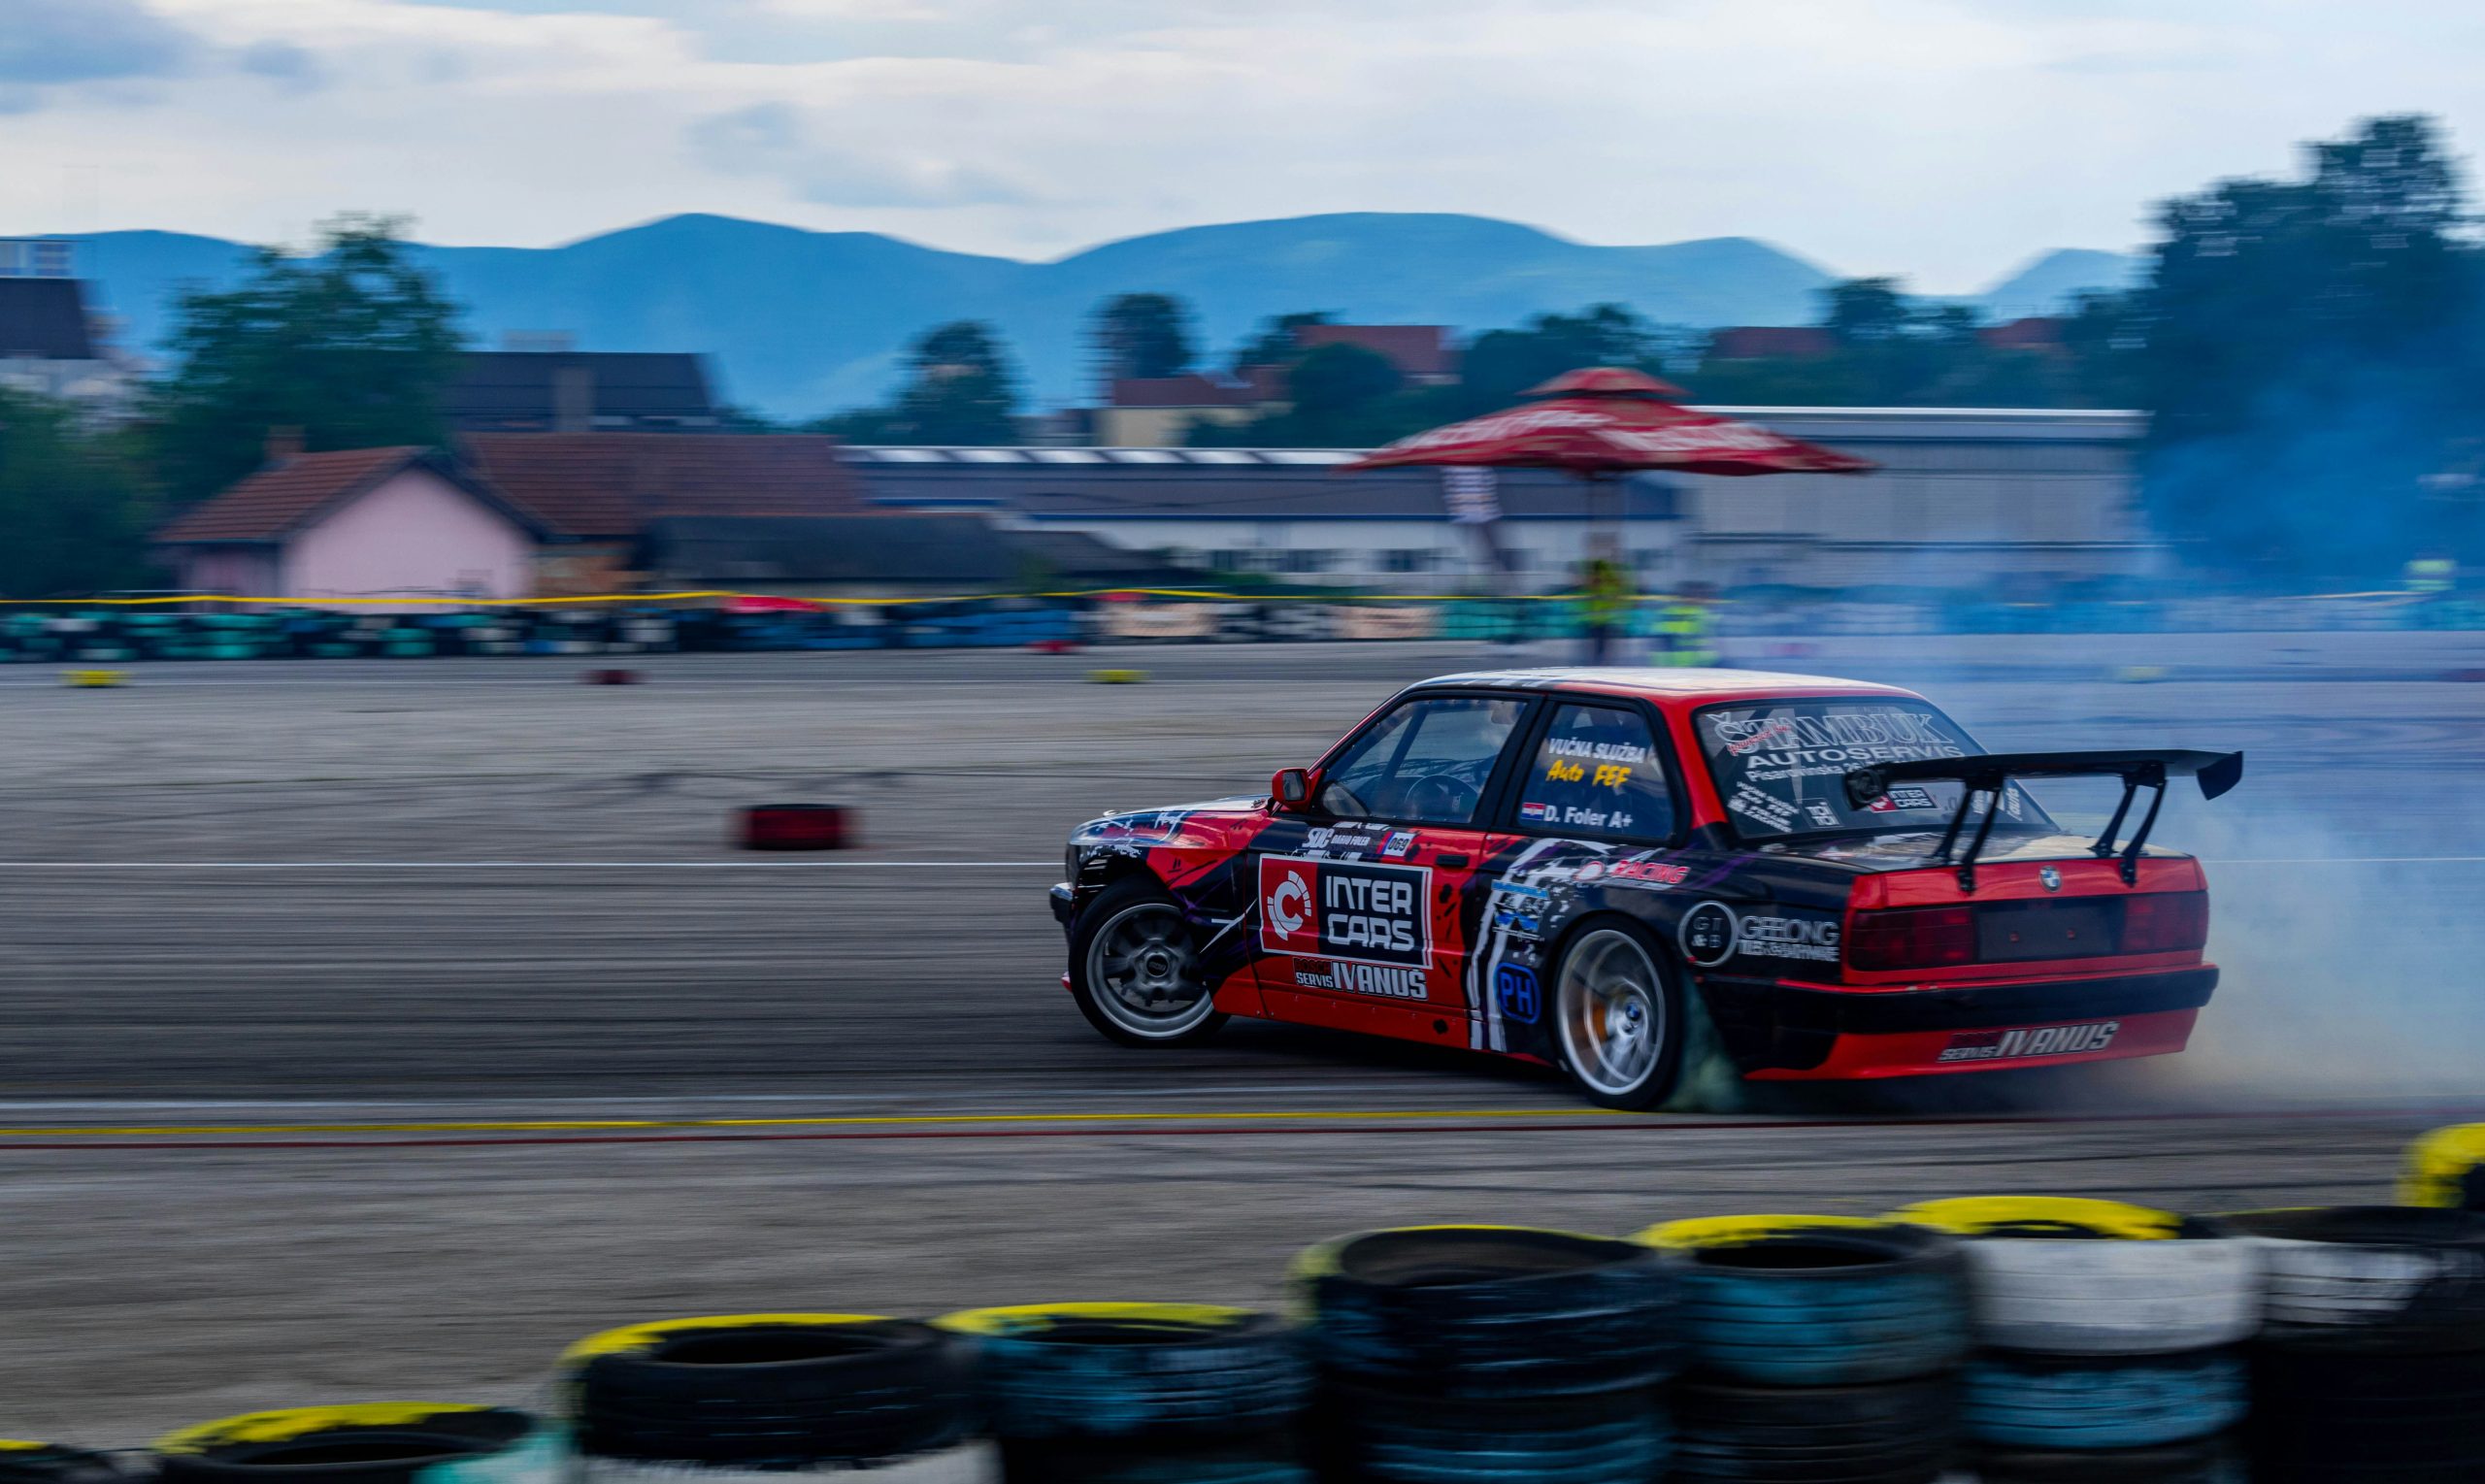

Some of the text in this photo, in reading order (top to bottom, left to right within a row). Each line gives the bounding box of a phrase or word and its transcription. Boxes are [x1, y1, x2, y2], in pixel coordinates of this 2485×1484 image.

[1548, 737, 1647, 764] VUČNA SLUŽBA
[1747, 744, 1966, 770] AUTOSERVIS
[1545, 759, 1633, 788] Auto FEF
[1543, 805, 1634, 829] D. Foler A+
[1387, 837, 1410, 852] 069
[1607, 860, 1691, 884] RACING
[1326, 875, 1413, 915] INTER
[1327, 913, 1415, 952] CARS
[1296, 972, 1334, 989] SERVIS
[1500, 972, 1534, 1016] PH
[1938, 1045, 1997, 1061] SERVIS
